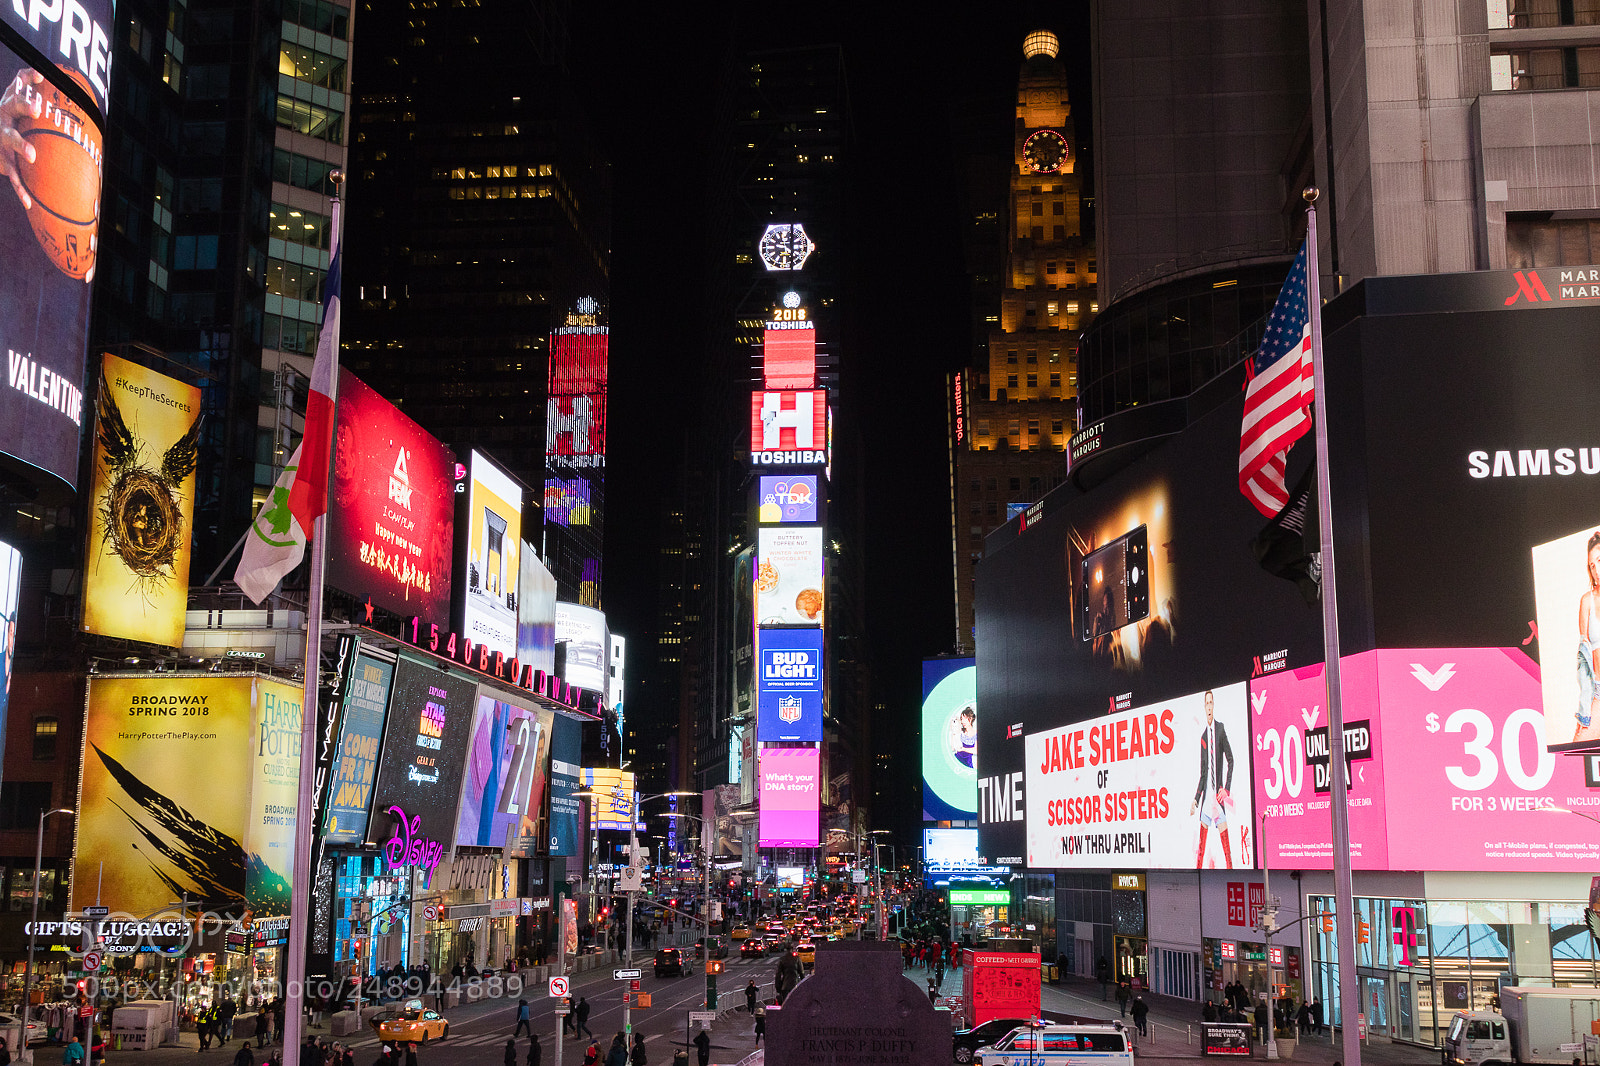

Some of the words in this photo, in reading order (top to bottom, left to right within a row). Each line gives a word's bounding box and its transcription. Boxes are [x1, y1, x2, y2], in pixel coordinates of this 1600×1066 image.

[1561, 270, 1599, 282] MAR
[774, 309, 806, 321] 2018
[765, 321, 814, 330] TOSHIBA
[115, 377, 191, 413] #KeepTheSecrets
[760, 391, 814, 450] H
[1072, 422, 1105, 447] MARRIOTT
[1072, 437, 1101, 461] MARQUIS
[751, 451, 826, 464] TOSHIBA
[1468, 447, 1600, 479] SAMSU
[388, 475, 412, 511] PEAK
[775, 492, 813, 504] TDK
[375, 522, 395, 545] Happy
[408, 541, 422, 557] year
[229, 650, 263, 659] LAMAR
[410, 616, 471, 665] 1540
[480, 644, 582, 708] BROADWAY
[772, 652, 809, 665] BUD
[1263, 649, 1288, 663] MARRIOTT
[1263, 659, 1286, 672] MARQUIS
[131, 695, 208, 705] BROADWAY
[129, 706, 178, 716] SPRING
[182, 706, 210, 716] 2018
[421, 701, 446, 722] STAR
[781, 707, 799, 719] NFL
[419, 716, 445, 738] WARS
[118, 731, 217, 741] HarryPotterThePlay.com
[1040, 730, 1085, 775] JAKE
[1089, 709, 1175, 766] SHEARS
[1306, 727, 1370, 758] UNLTED
[344, 732, 378, 761] COME
[1425, 707, 1556, 792] $30
[1256, 724, 1304, 800] $30
[285, 766, 299, 779] CHIL
[765, 773, 793, 781] What's
[795, 775, 814, 783] your
[1097, 769, 1109, 789] OF
[1315, 763, 1351, 788] DA
[334, 782, 371, 809] AWAY
[765, 783, 785, 791] DNA
[786, 783, 814, 793] story?
[978, 771, 1024, 823] TIME
[1451, 797, 1483, 812] FOR
[1487, 797, 1497, 811] 3
[1499, 797, 1556, 811] WEEKS
[1566, 797, 1600, 806] INCLUD
[264, 804, 296, 815] BROADWAY
[1047, 795, 1102, 827] SCISSOR
[1105, 786, 1169, 822] SISTERS
[1266, 804, 1279, 817] FOR
[1278, 803, 1284, 816] 3
[1283, 802, 1304, 816] WEEKS
[263, 816, 284, 826] SPRING
[285, 816, 296, 826] 2018
[1062, 836, 1083, 855] NOW
[1085, 833, 1111, 854] THRU
[1113, 832, 1146, 854] APRIL
[24, 921, 82, 936] GIFTS
[97, 922, 191, 936] LUGGAGE
[260, 919, 290, 932] LUGGAGE
[809, 1027, 862, 1037] LIEUTENANT
[864, 1027, 906, 1037] COLONEL
[800, 1039, 855, 1052] FRANCIS
[871, 1039, 917, 1052] DUFFY
